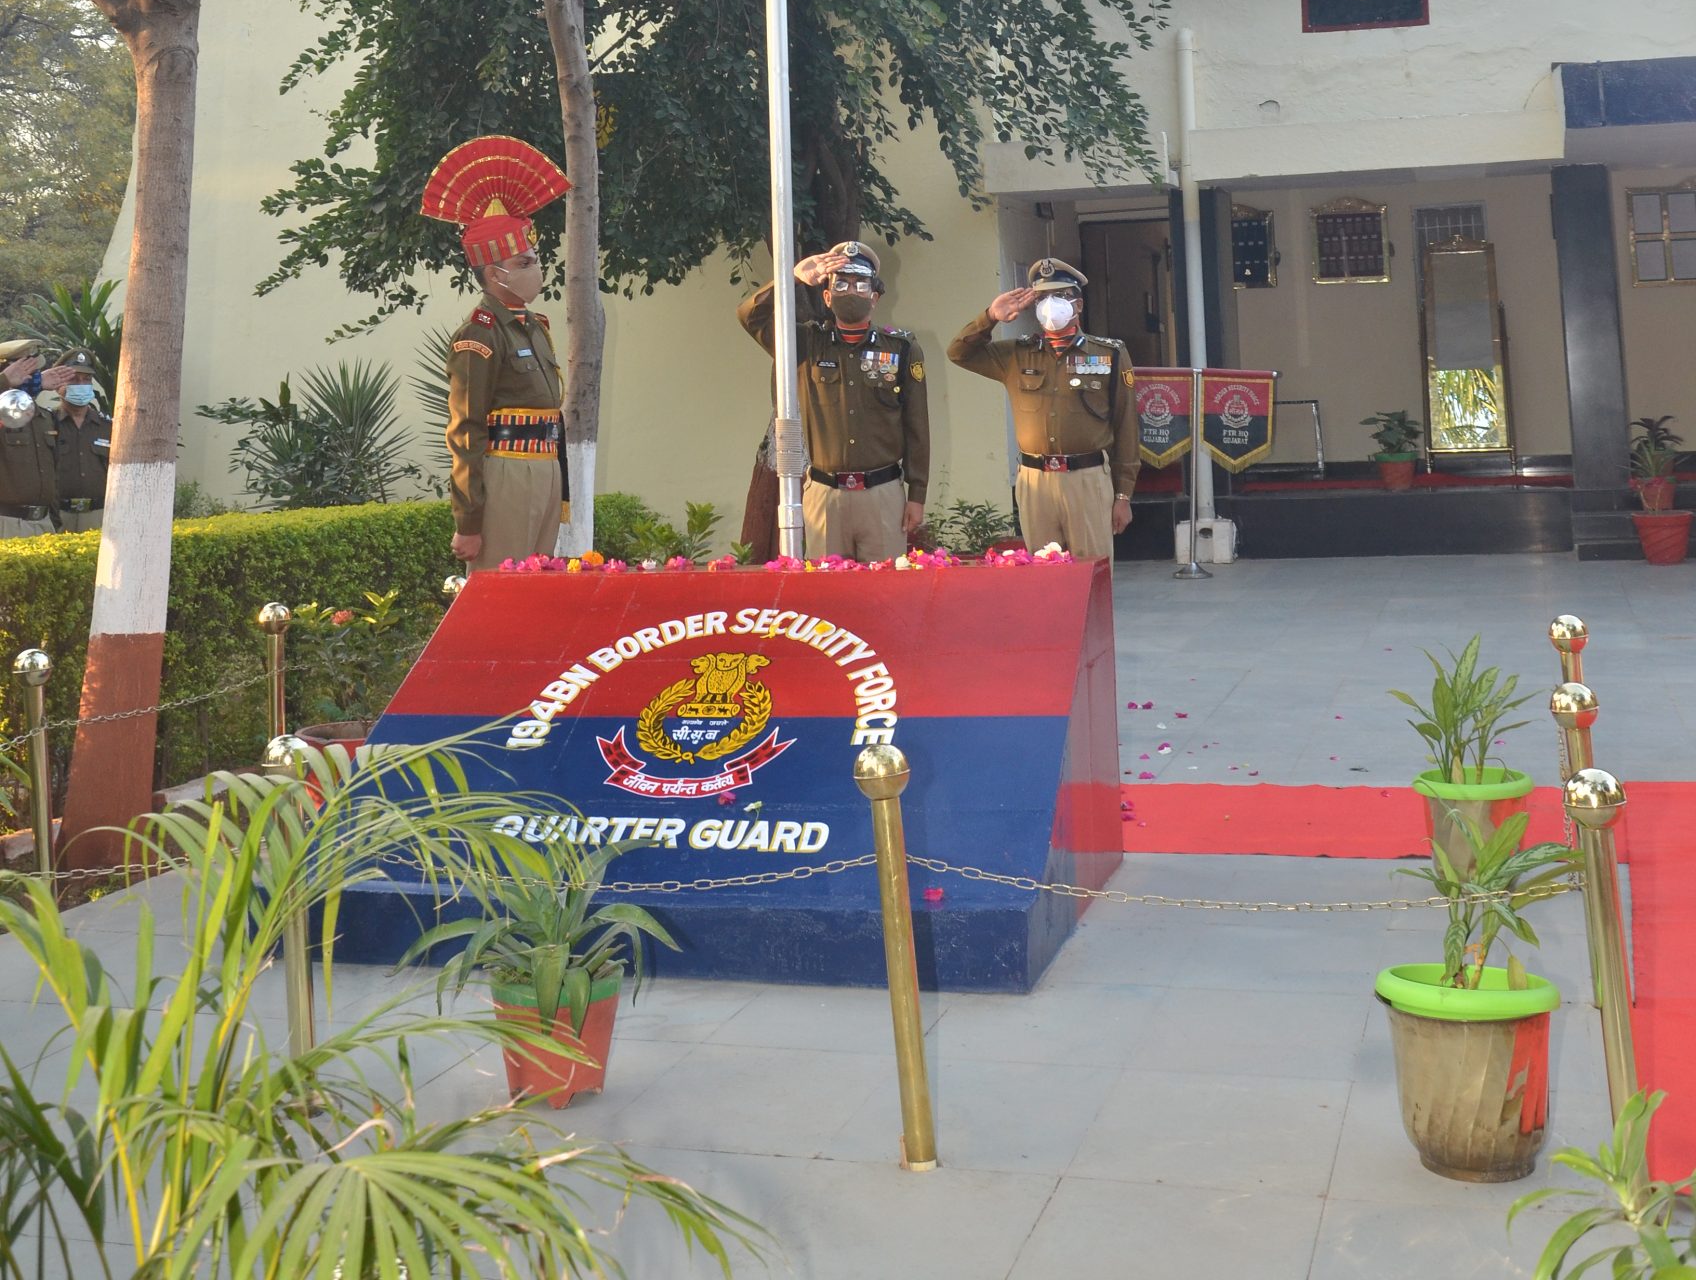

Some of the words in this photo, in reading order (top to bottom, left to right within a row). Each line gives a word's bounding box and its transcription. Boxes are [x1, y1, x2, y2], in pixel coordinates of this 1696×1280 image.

[1159, 428, 1170, 437] HQ
[1238, 430, 1249, 439] HQ
[1143, 435, 1169, 443] GUJARAT
[1222, 437, 1249, 445] GUJARAT
[506, 663, 601, 748] 194BN
[586, 611, 728, 673] BORDER
[729, 607, 877, 667] SECURITY
[846, 661, 898, 745] FORCE
[622, 774, 660, 793] जीवन
[492, 815, 686, 849] QUARTER
[688, 819, 830, 853] GUARD
